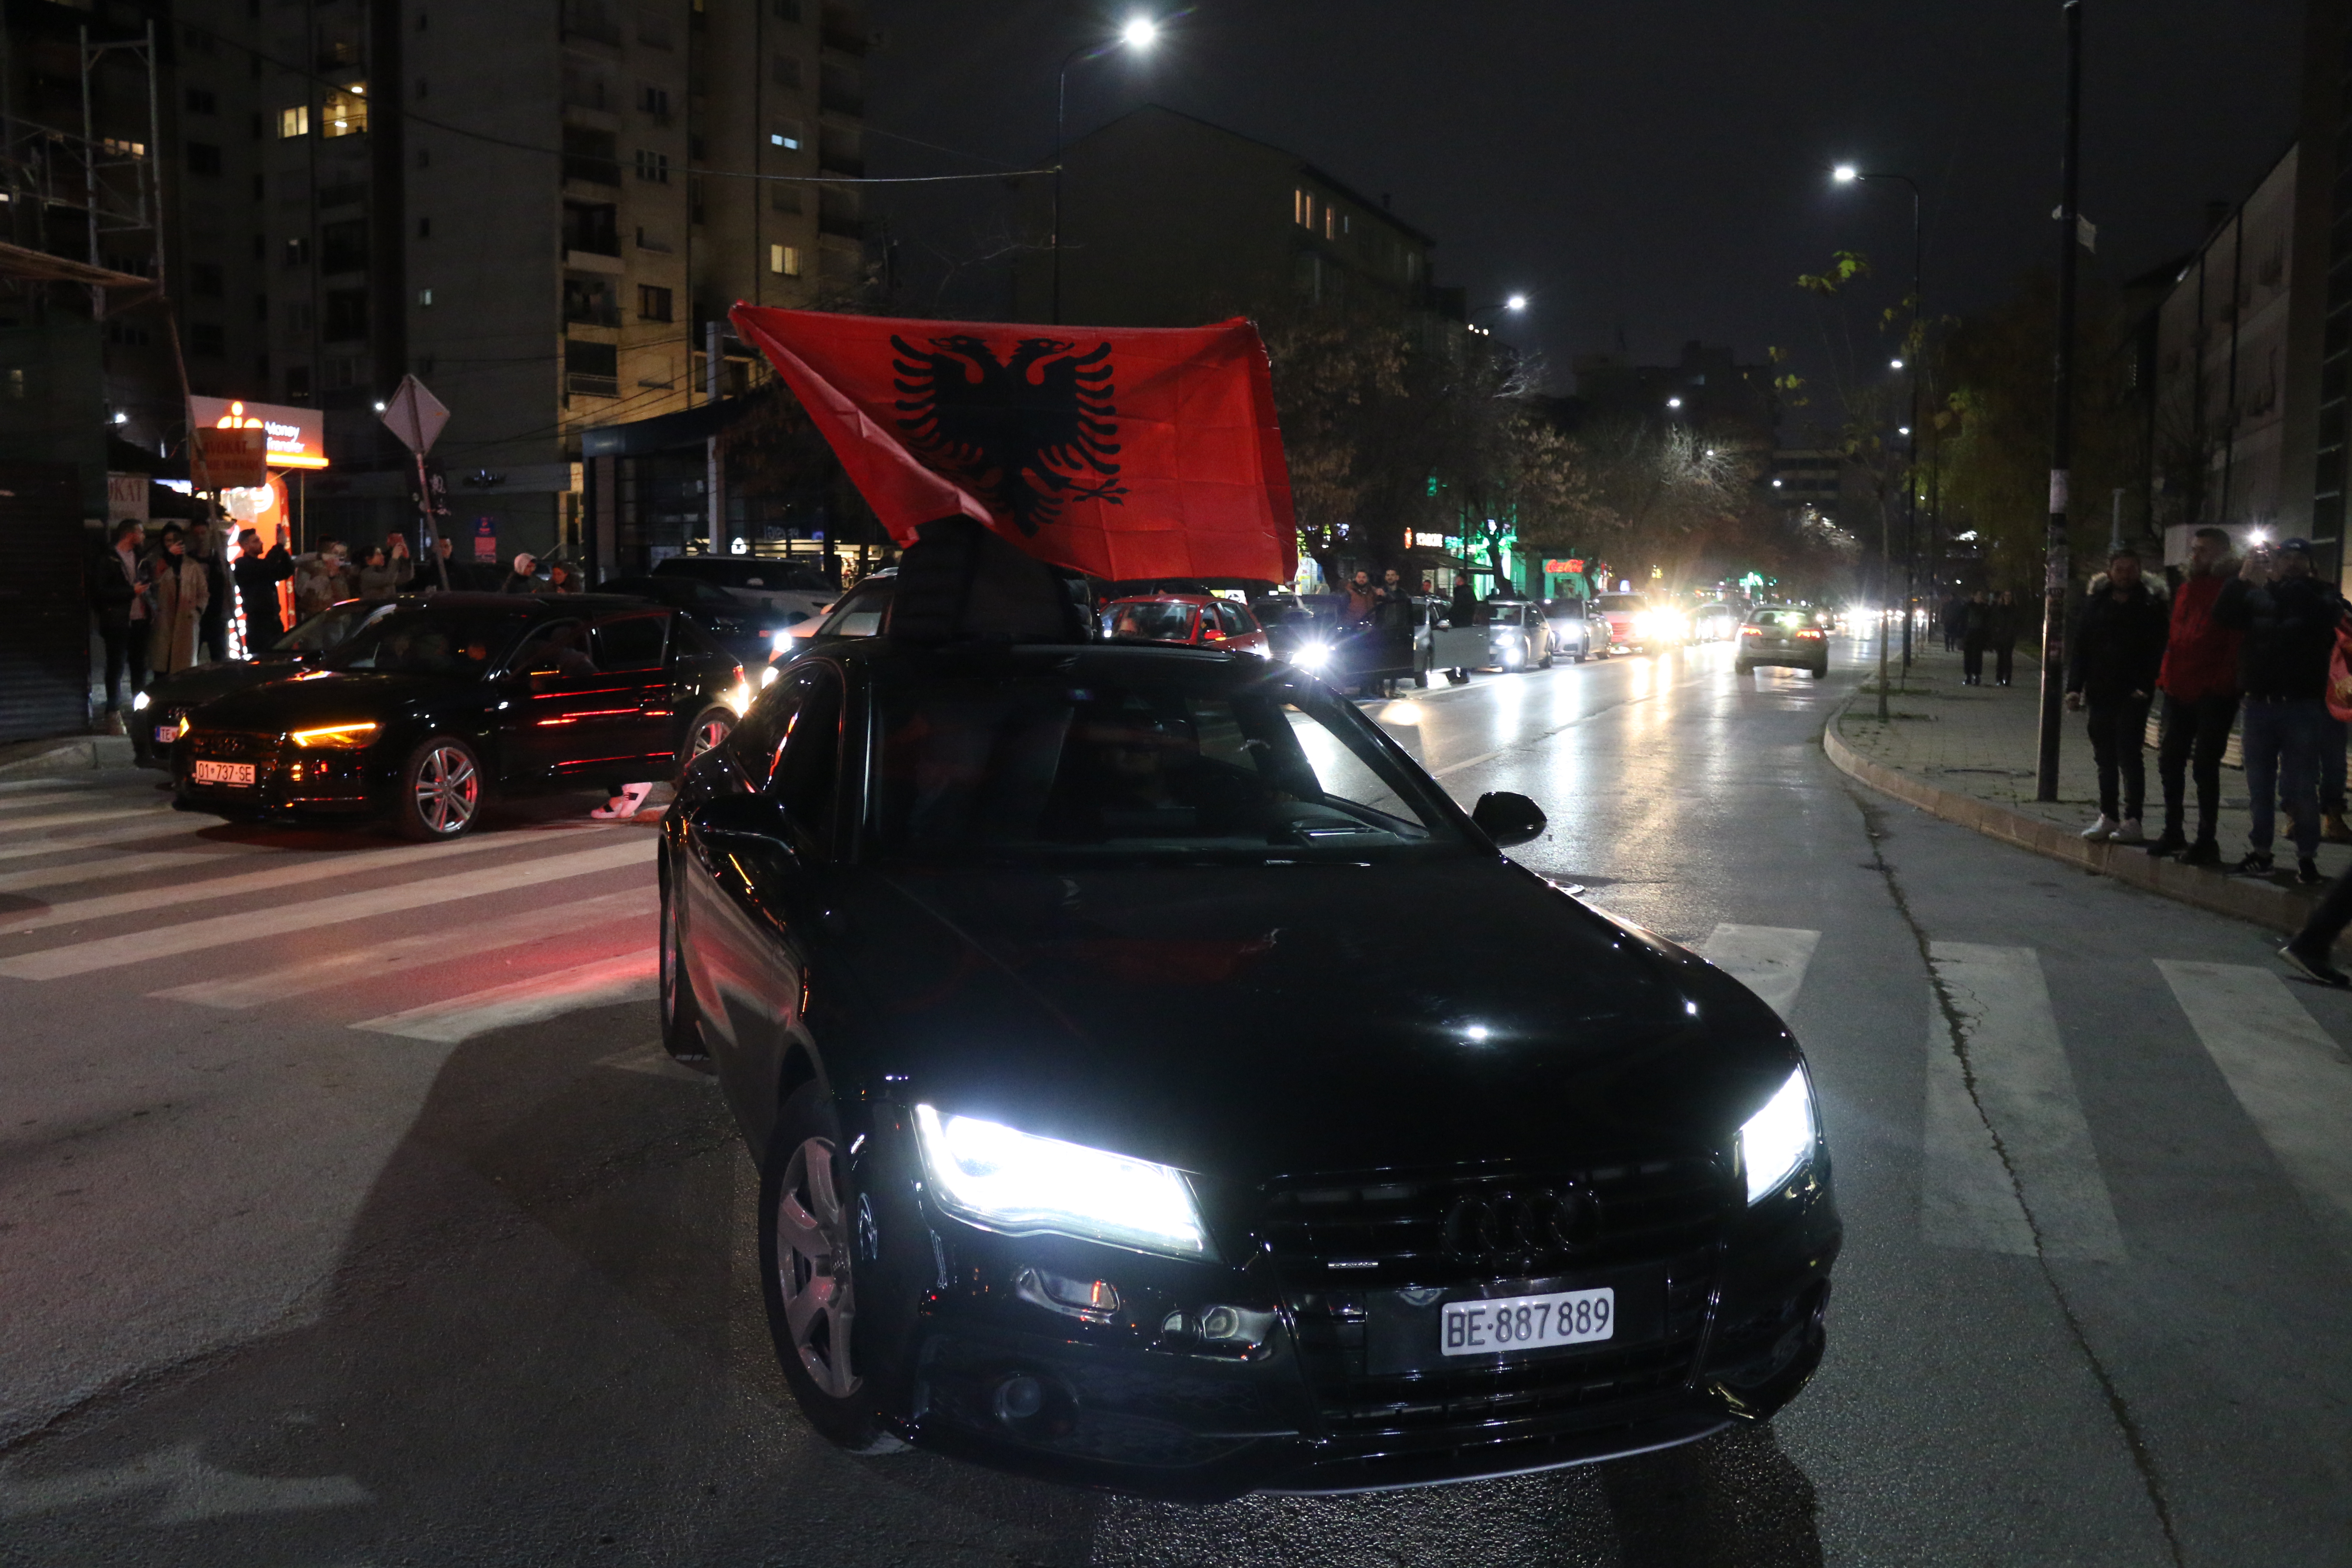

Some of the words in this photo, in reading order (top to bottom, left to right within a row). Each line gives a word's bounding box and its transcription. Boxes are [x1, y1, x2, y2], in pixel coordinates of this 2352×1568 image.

[265, 421, 300, 442] Money
[266, 437, 305, 453] Transfer
[1557, 1298, 1610, 1336] 889
